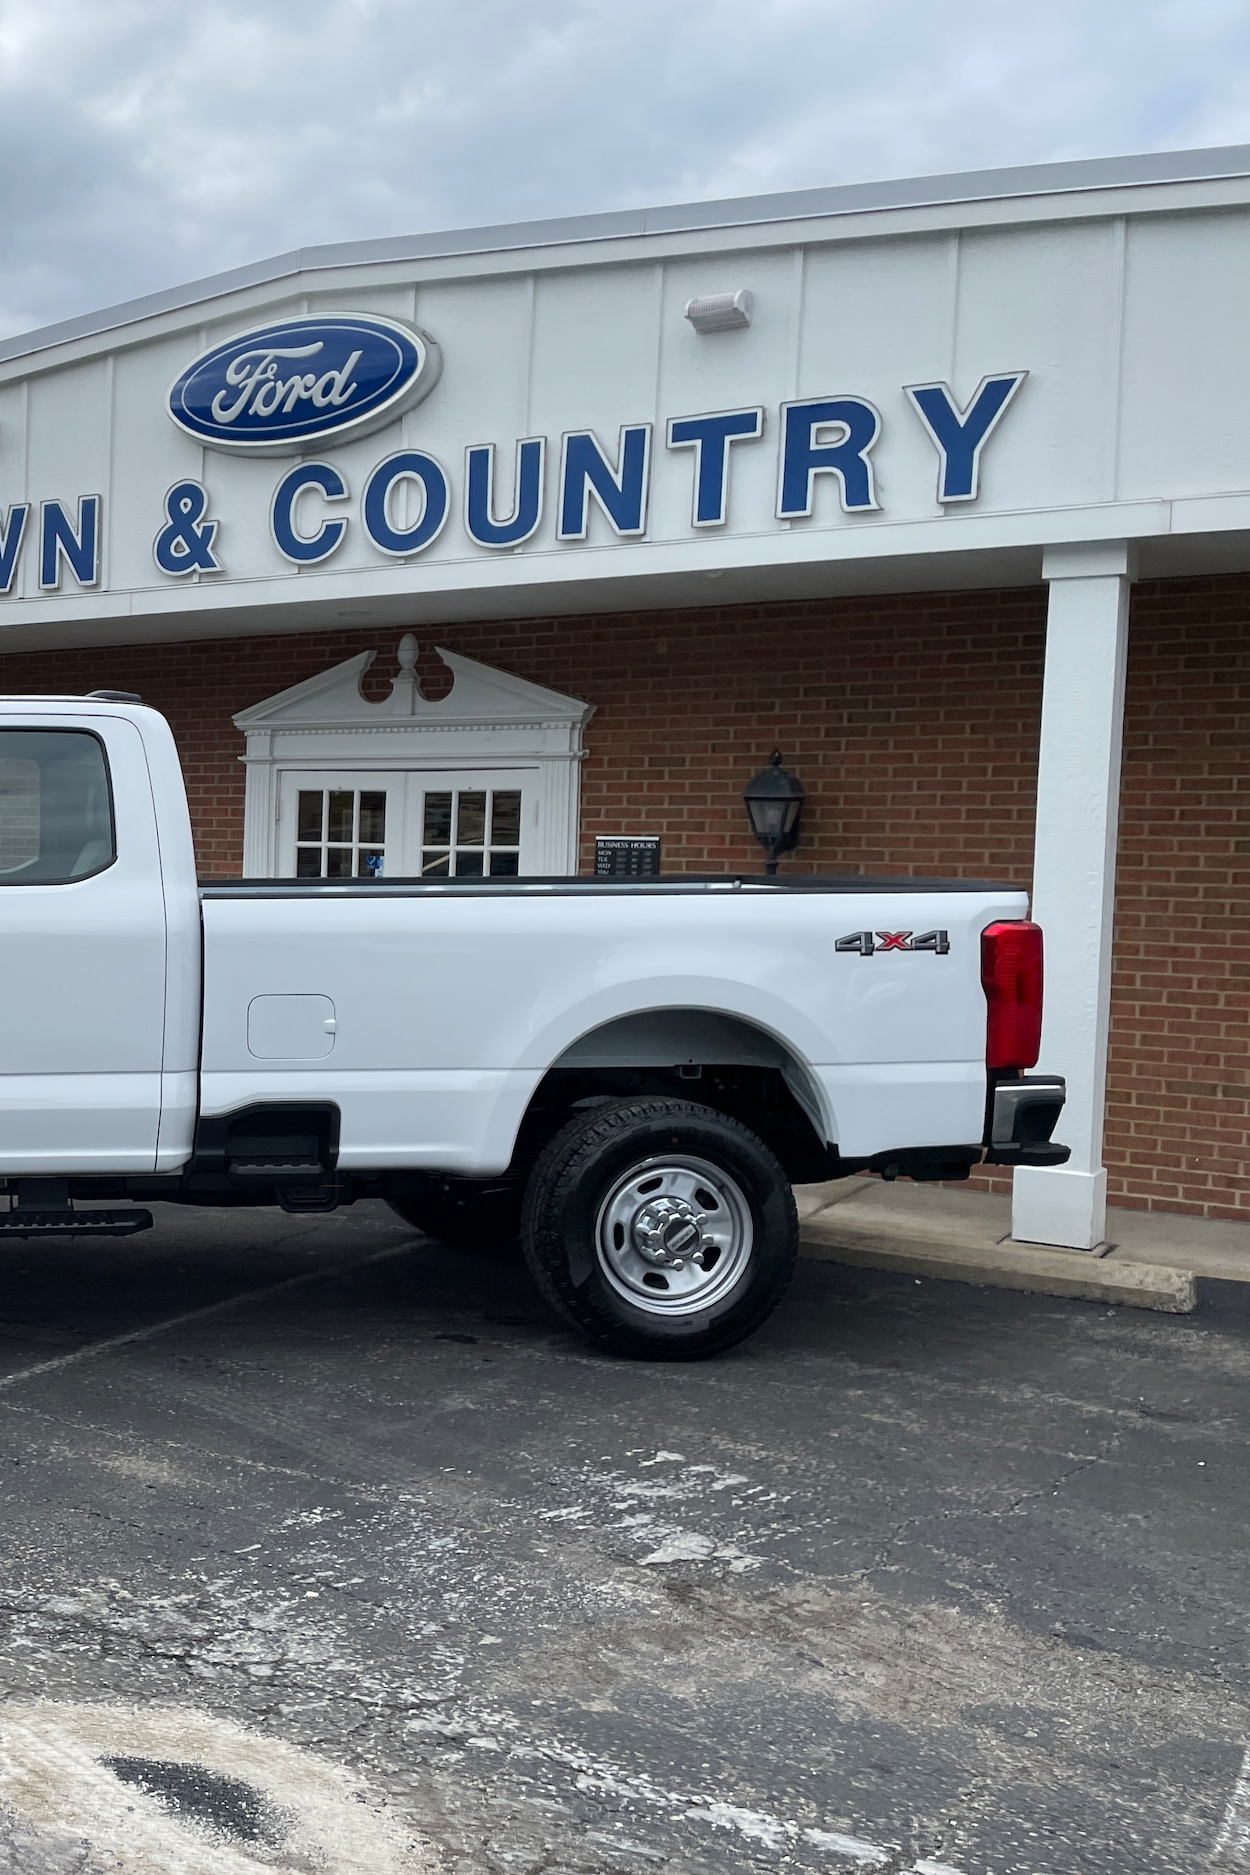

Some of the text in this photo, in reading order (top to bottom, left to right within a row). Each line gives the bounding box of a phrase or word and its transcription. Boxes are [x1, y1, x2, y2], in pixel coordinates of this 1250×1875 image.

[211, 341, 363, 423] Ford
[153, 479, 225, 576] &
[270, 371, 1029, 565] COUNTRY
